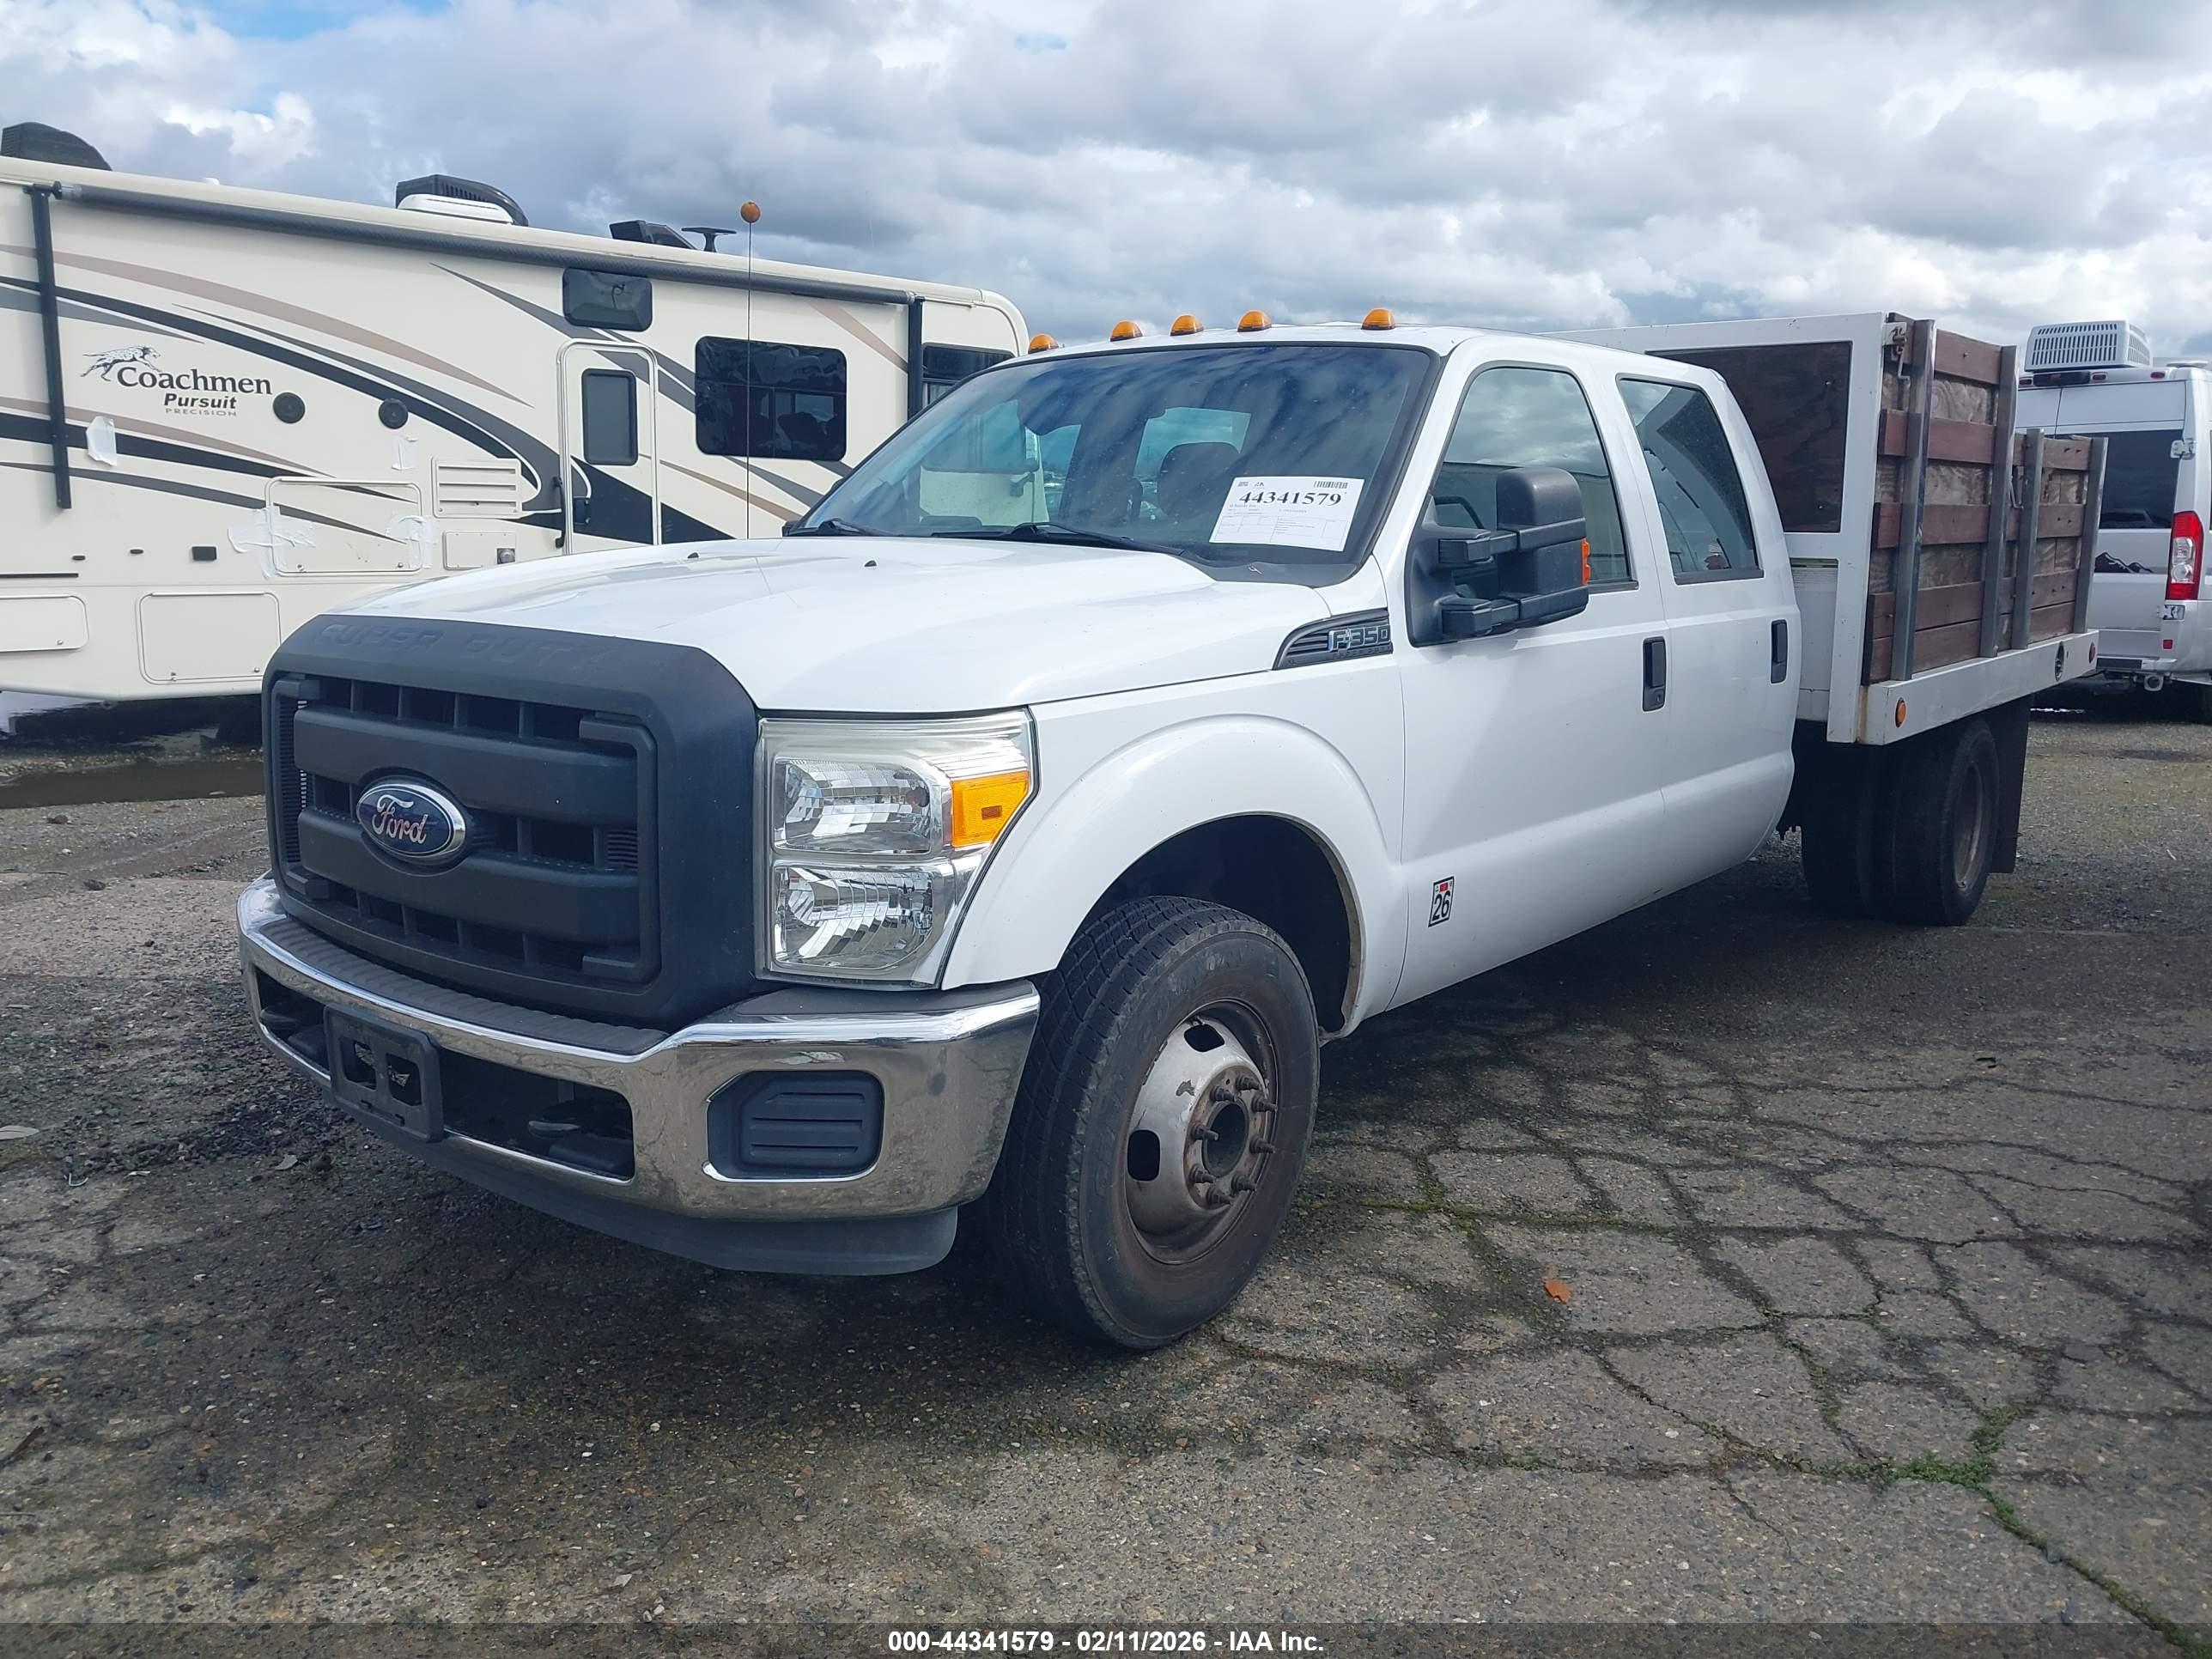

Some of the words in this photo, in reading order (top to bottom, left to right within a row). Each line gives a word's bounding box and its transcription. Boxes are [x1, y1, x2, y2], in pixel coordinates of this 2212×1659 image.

[116, 366, 273, 394] Coachmen
[163, 392, 238, 409] Pursuit
[165, 408, 238, 416] PRECISION
[1239, 491, 1341, 506] 44341579
[315, 623, 445, 653] SUPER
[1328, 624, 1391, 653] F-350
[372, 794, 428, 844] Ford
[1431, 890, 1451, 921] 26
